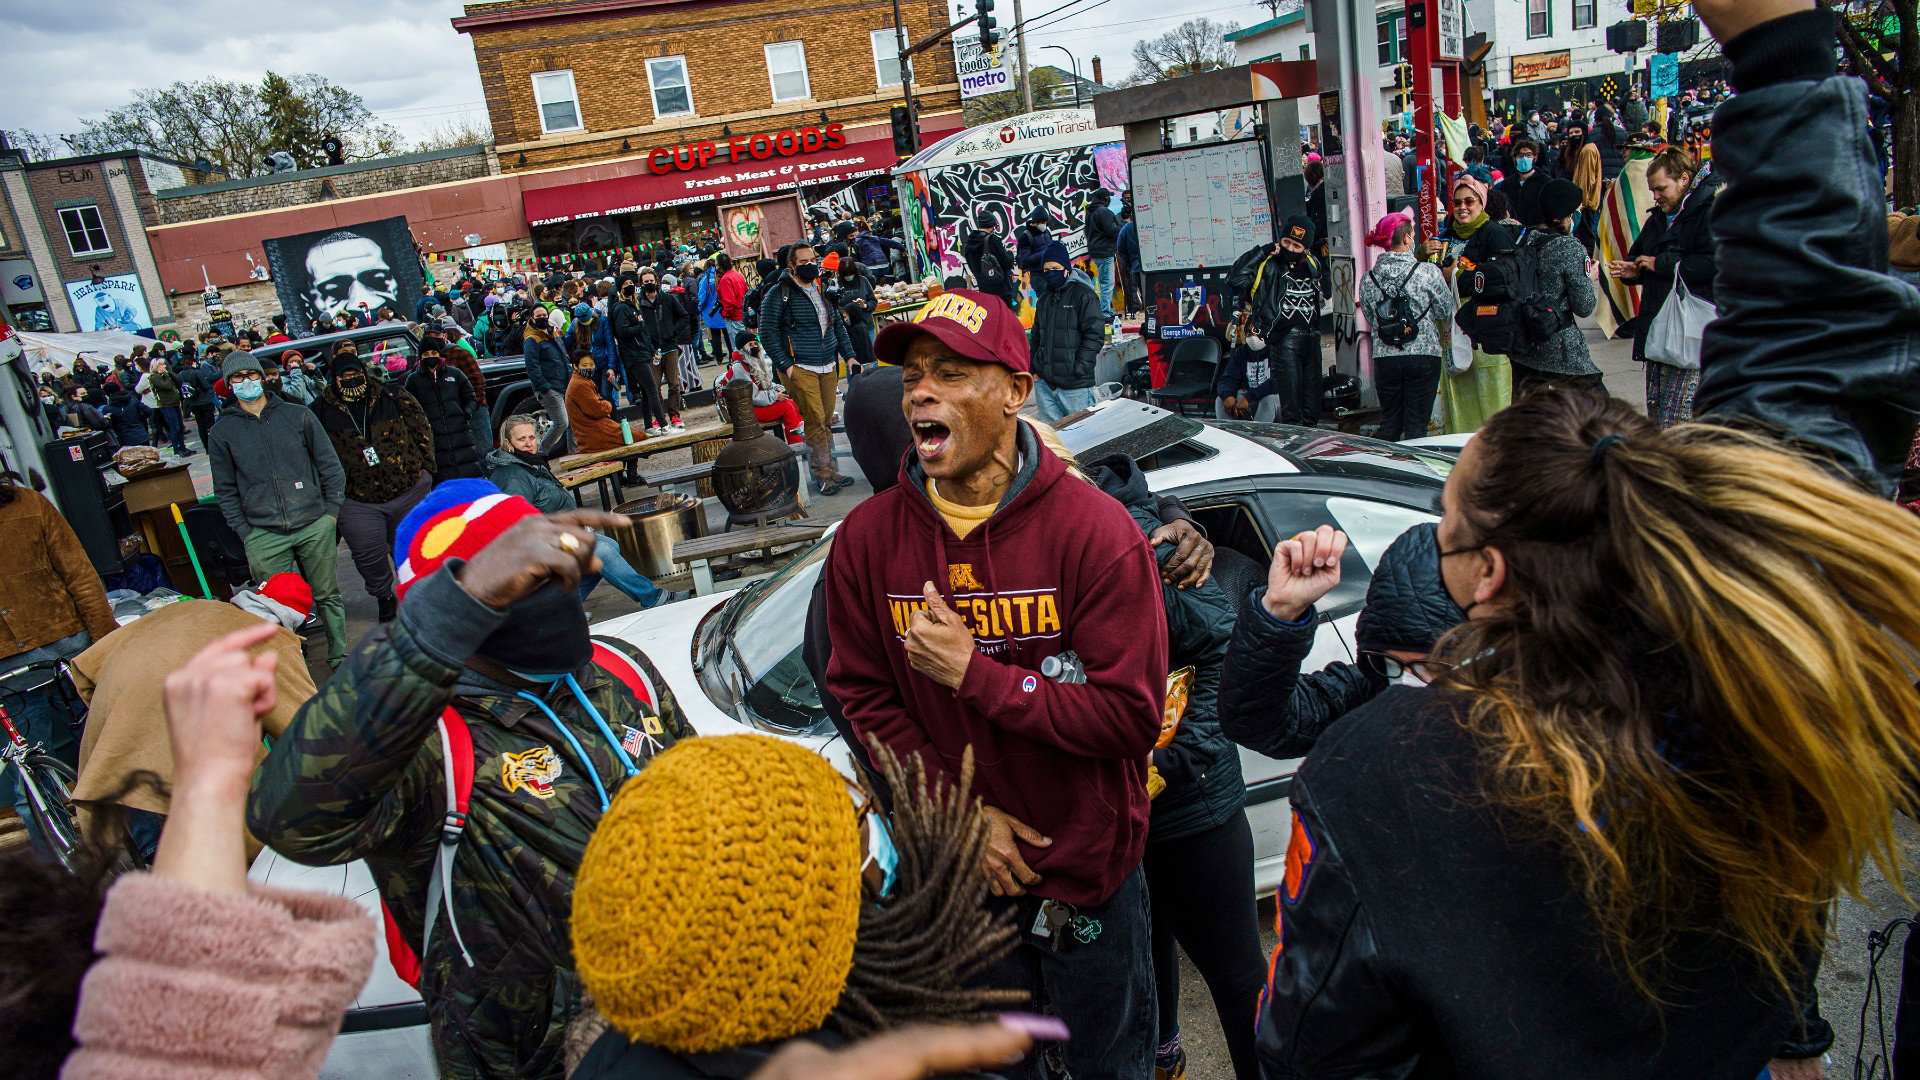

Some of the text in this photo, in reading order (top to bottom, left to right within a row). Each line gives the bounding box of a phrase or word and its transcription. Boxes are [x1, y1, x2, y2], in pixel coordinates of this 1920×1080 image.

[960, 45, 983, 61] Cup
[962, 71, 1006, 89] metro
[647, 123, 846, 175] CUP FOODS
[58, 168, 94, 184] BLM
[108, 169, 126, 179] BLM
[684, 156, 865, 189] Fresh Meat & Produce
[532, 215, 569, 227] STAMPS
[575, 211, 599, 220] KEYS
[605, 204, 642, 216] PHONES
[654, 193, 715, 210] ACCESSORIES
[721, 188, 739, 199] BUS
[740, 185, 771, 196] CARDS
[818, 174, 841, 185] MILK
[846, 167, 885, 180] T-SHIRTS
[102, 279, 136, 292] SPARK
[912, 292, 988, 334] PHERS
[1163, 328, 1181, 336] George
[888, 594, 1062, 637] MIESOTA
